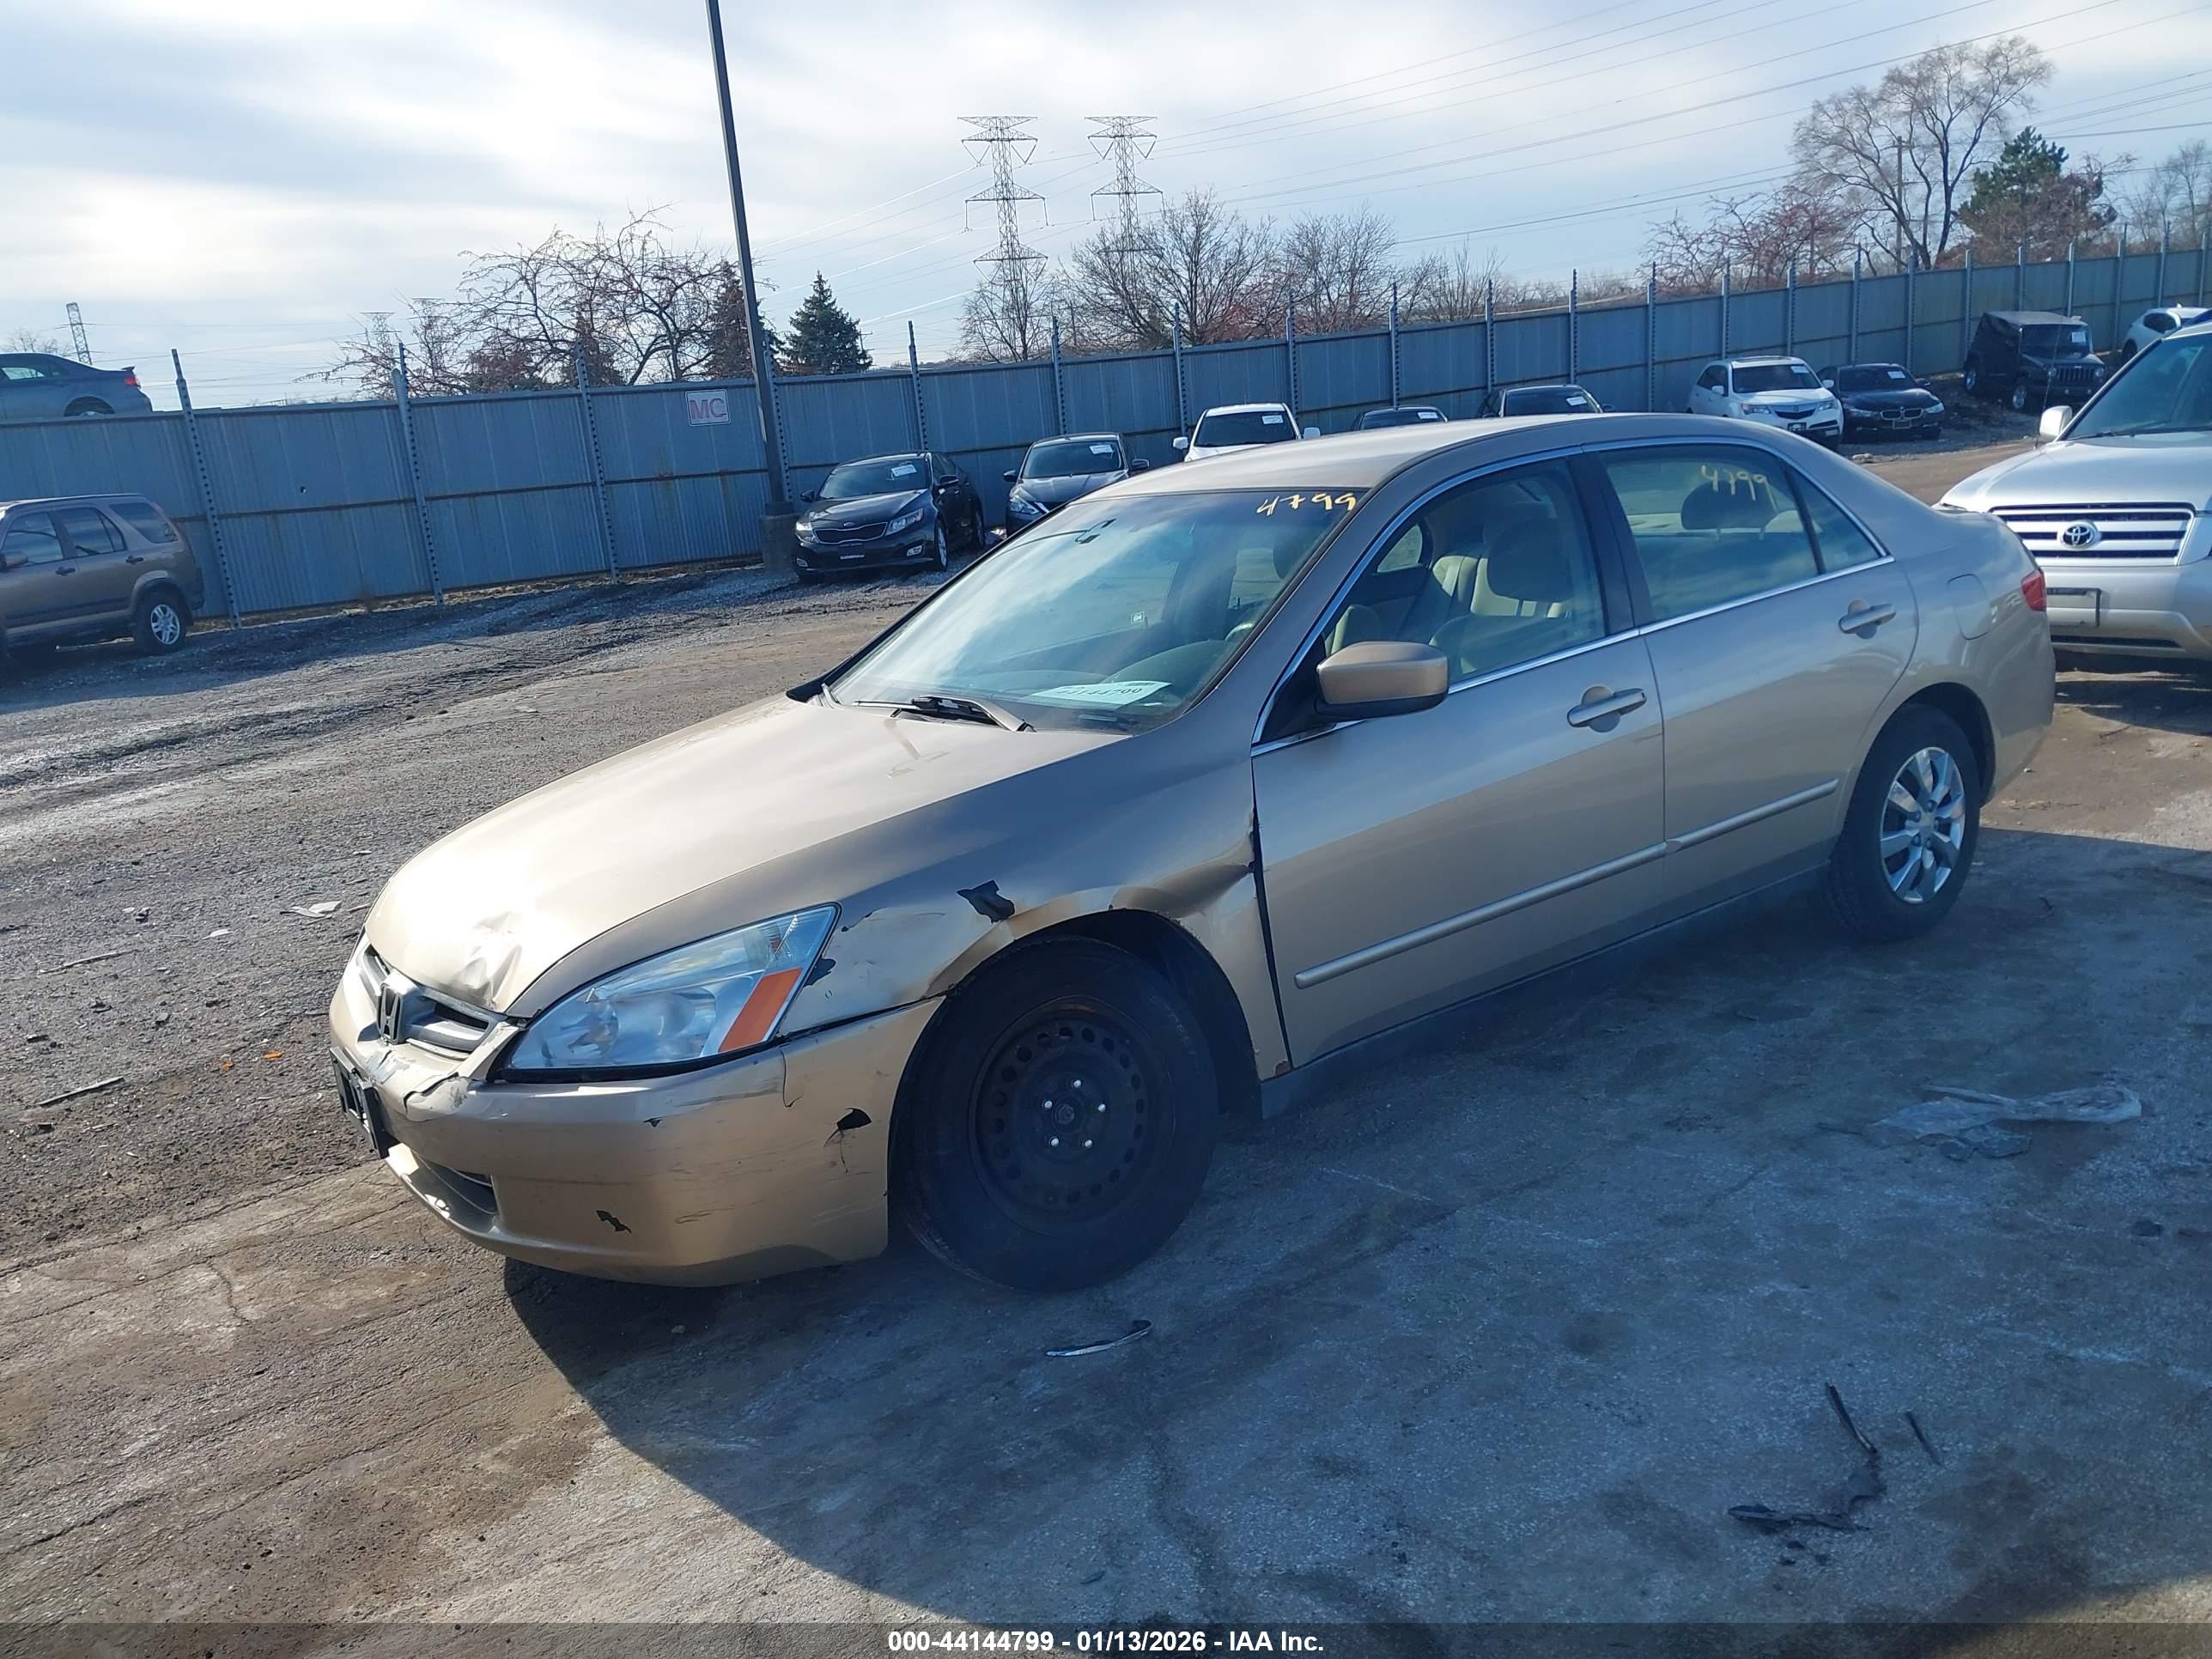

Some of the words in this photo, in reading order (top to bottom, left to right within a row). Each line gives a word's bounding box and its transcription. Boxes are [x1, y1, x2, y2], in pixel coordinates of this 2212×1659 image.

[690, 398, 727, 419] MC
[1700, 465, 1778, 512] 4799
[1256, 493, 1357, 517] 4799
